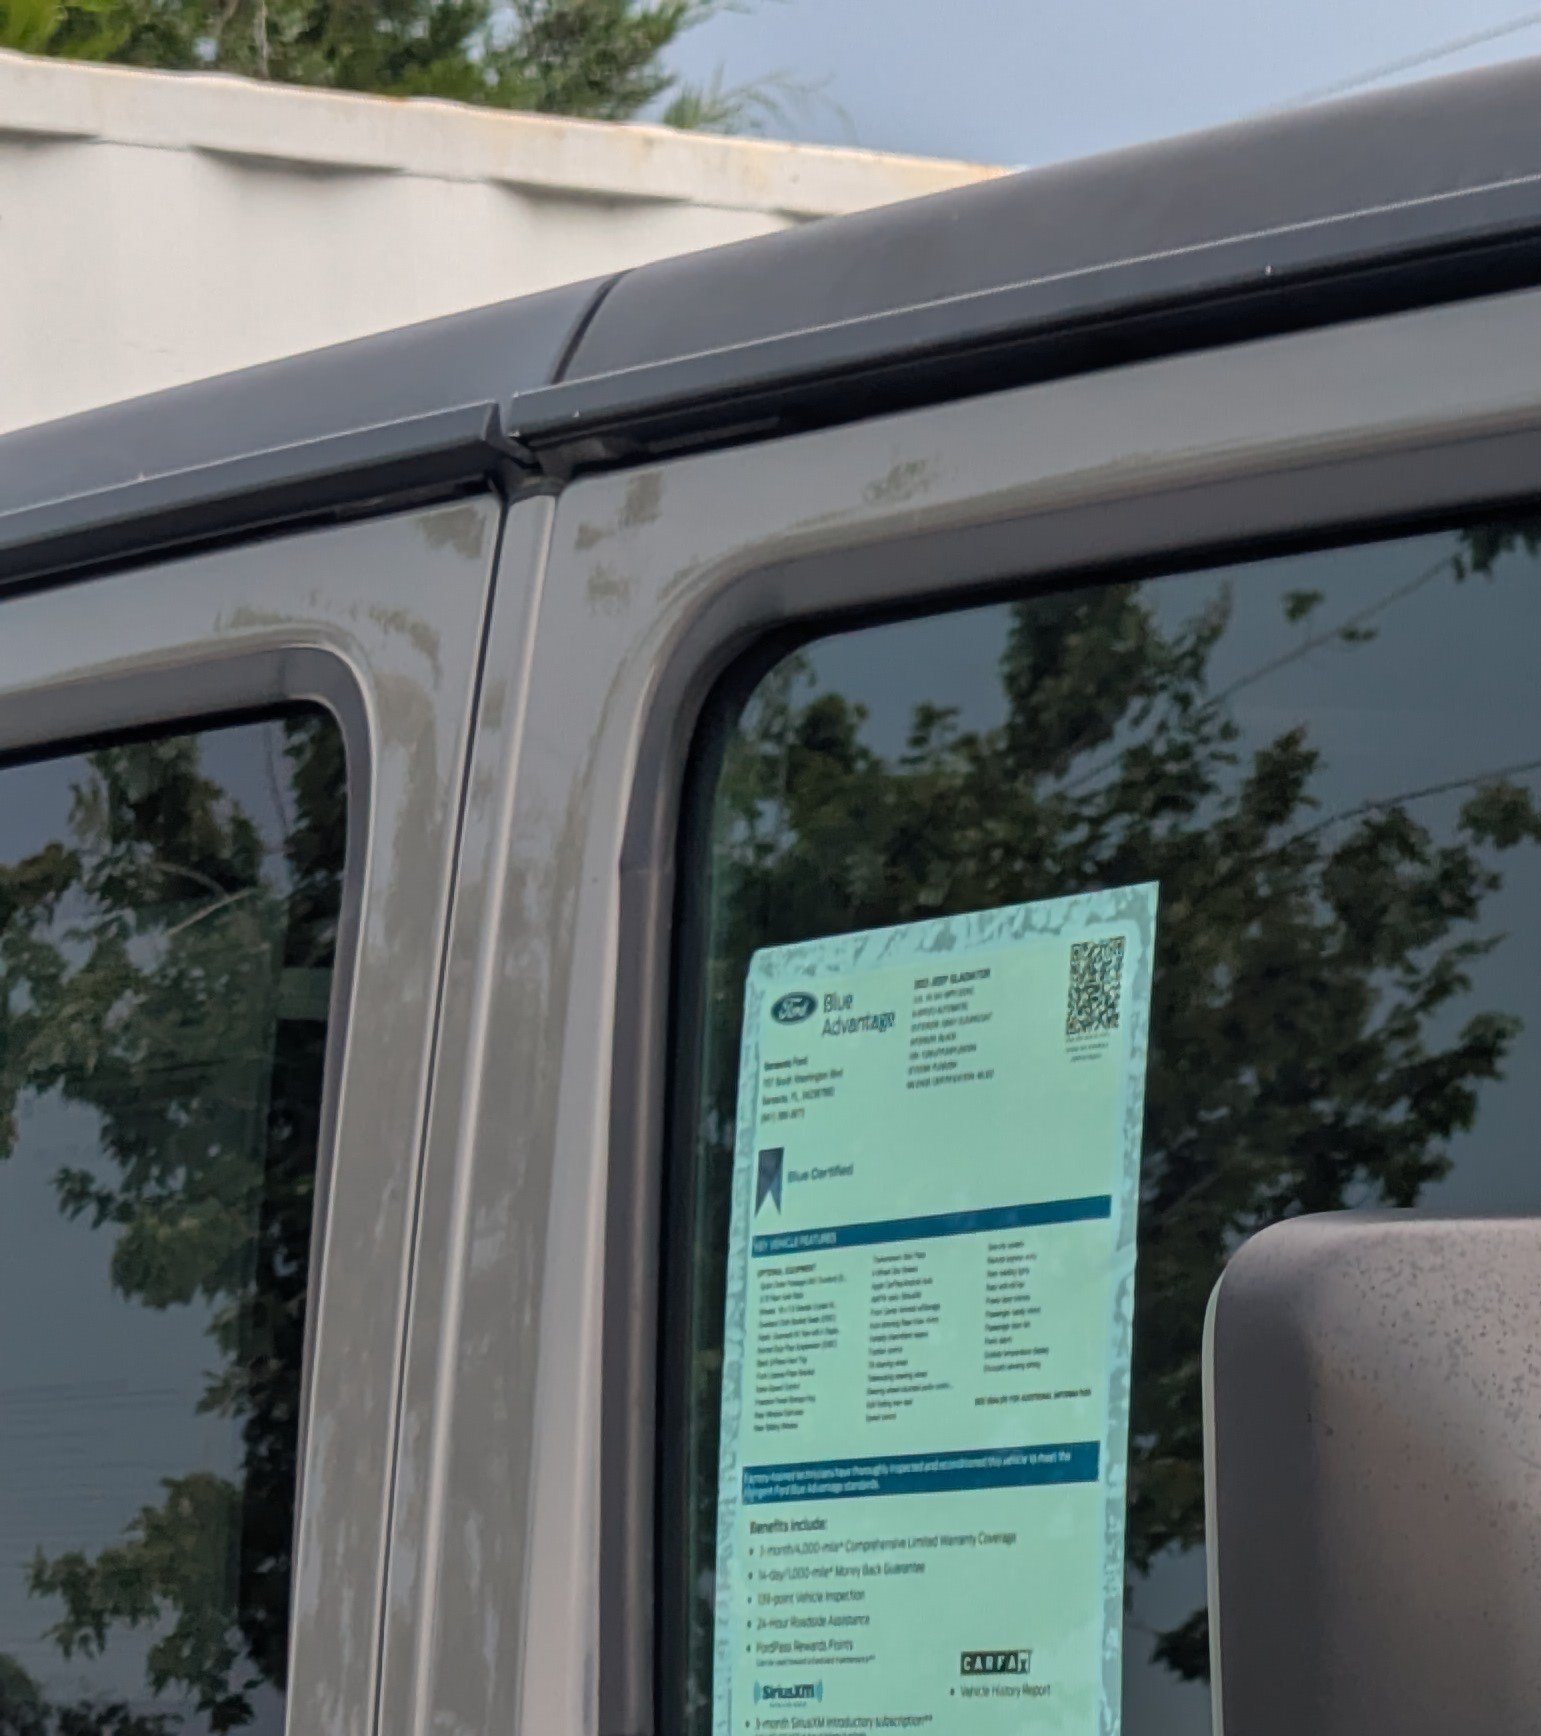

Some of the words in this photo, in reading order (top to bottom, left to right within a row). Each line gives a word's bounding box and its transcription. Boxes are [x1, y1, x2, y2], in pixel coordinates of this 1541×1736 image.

[823, 988, 854, 1013] Blue
[821, 1008, 896, 1041] Advantage
[787, 1167, 809, 1183] Blue
[811, 1161, 854, 1180] Certified
[749, 1518, 788, 1534] Benefits
